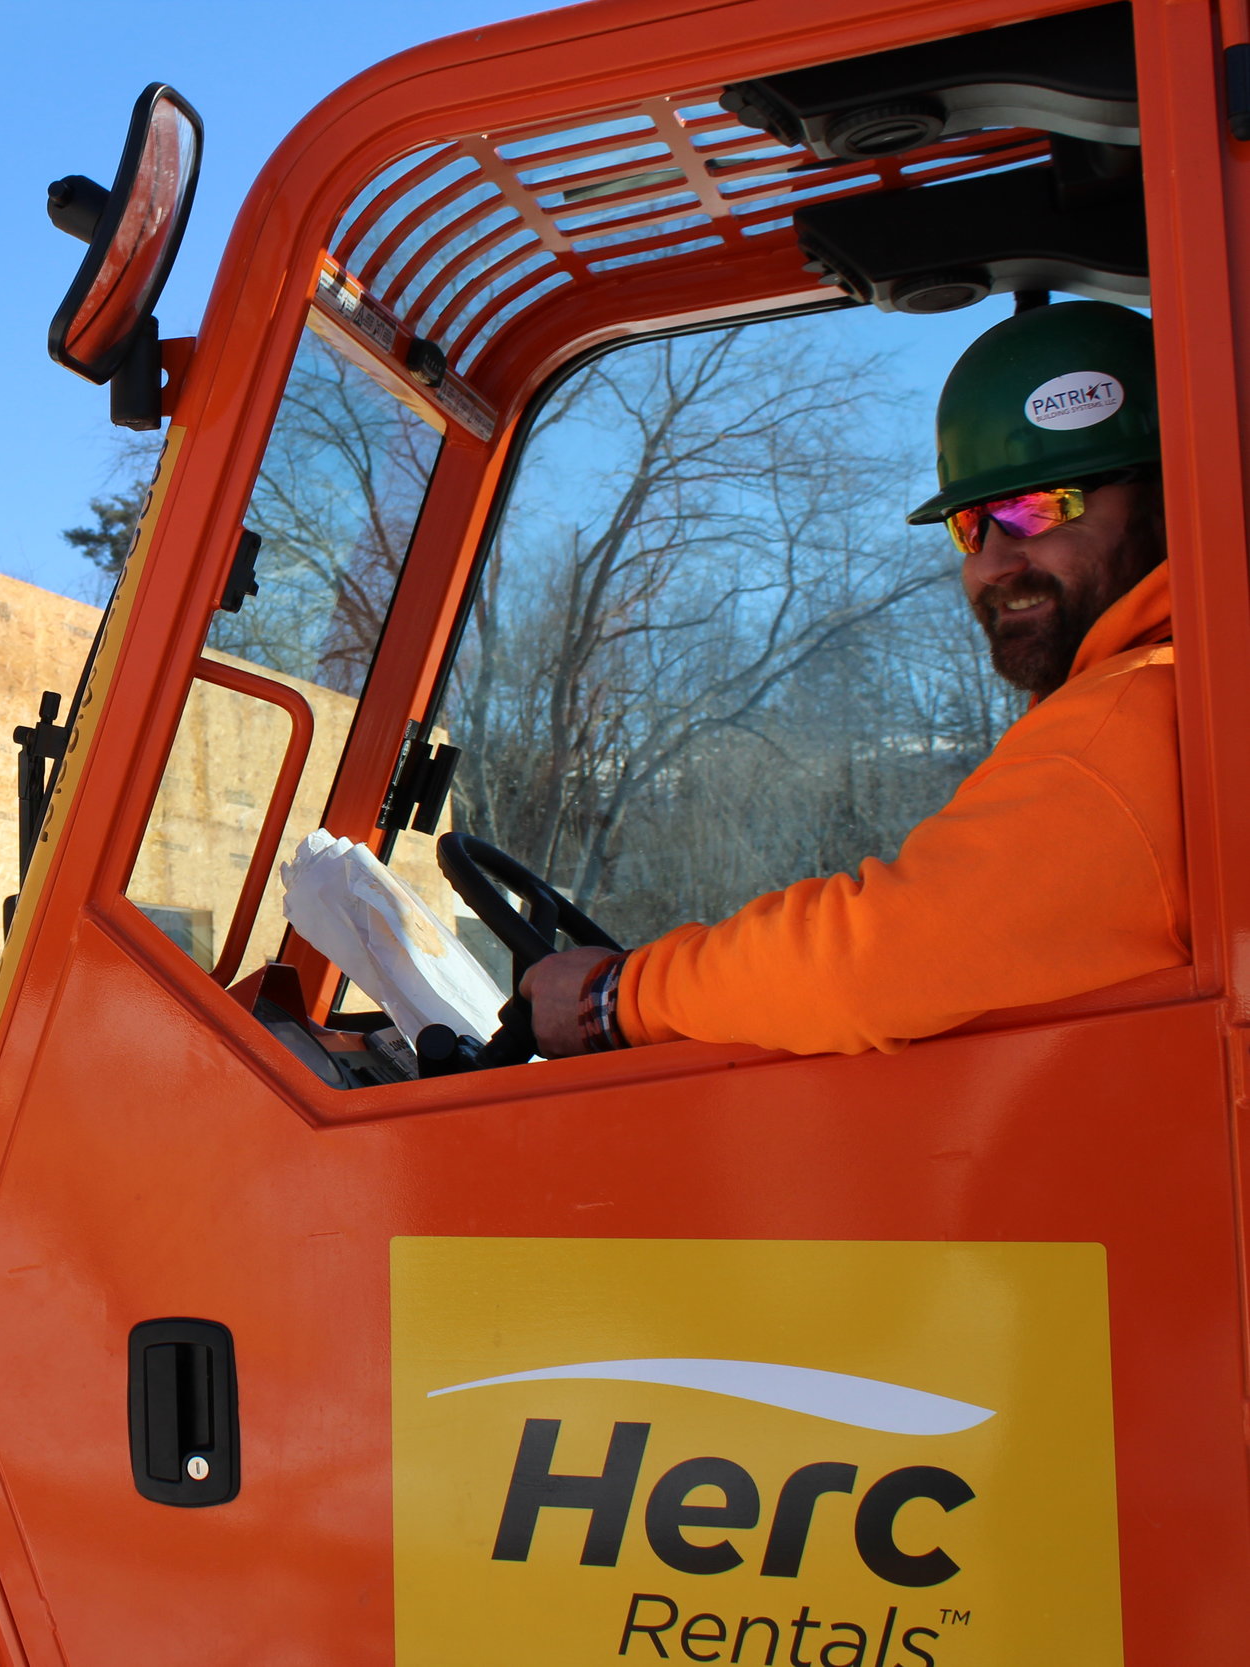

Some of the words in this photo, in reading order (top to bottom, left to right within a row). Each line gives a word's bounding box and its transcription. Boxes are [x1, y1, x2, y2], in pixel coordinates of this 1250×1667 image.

[1032, 382, 1113, 415] PATRIT
[1035, 409, 1070, 423] BUILDING
[491, 1417, 977, 1589] Herc
[617, 1592, 942, 1667] Rentals
